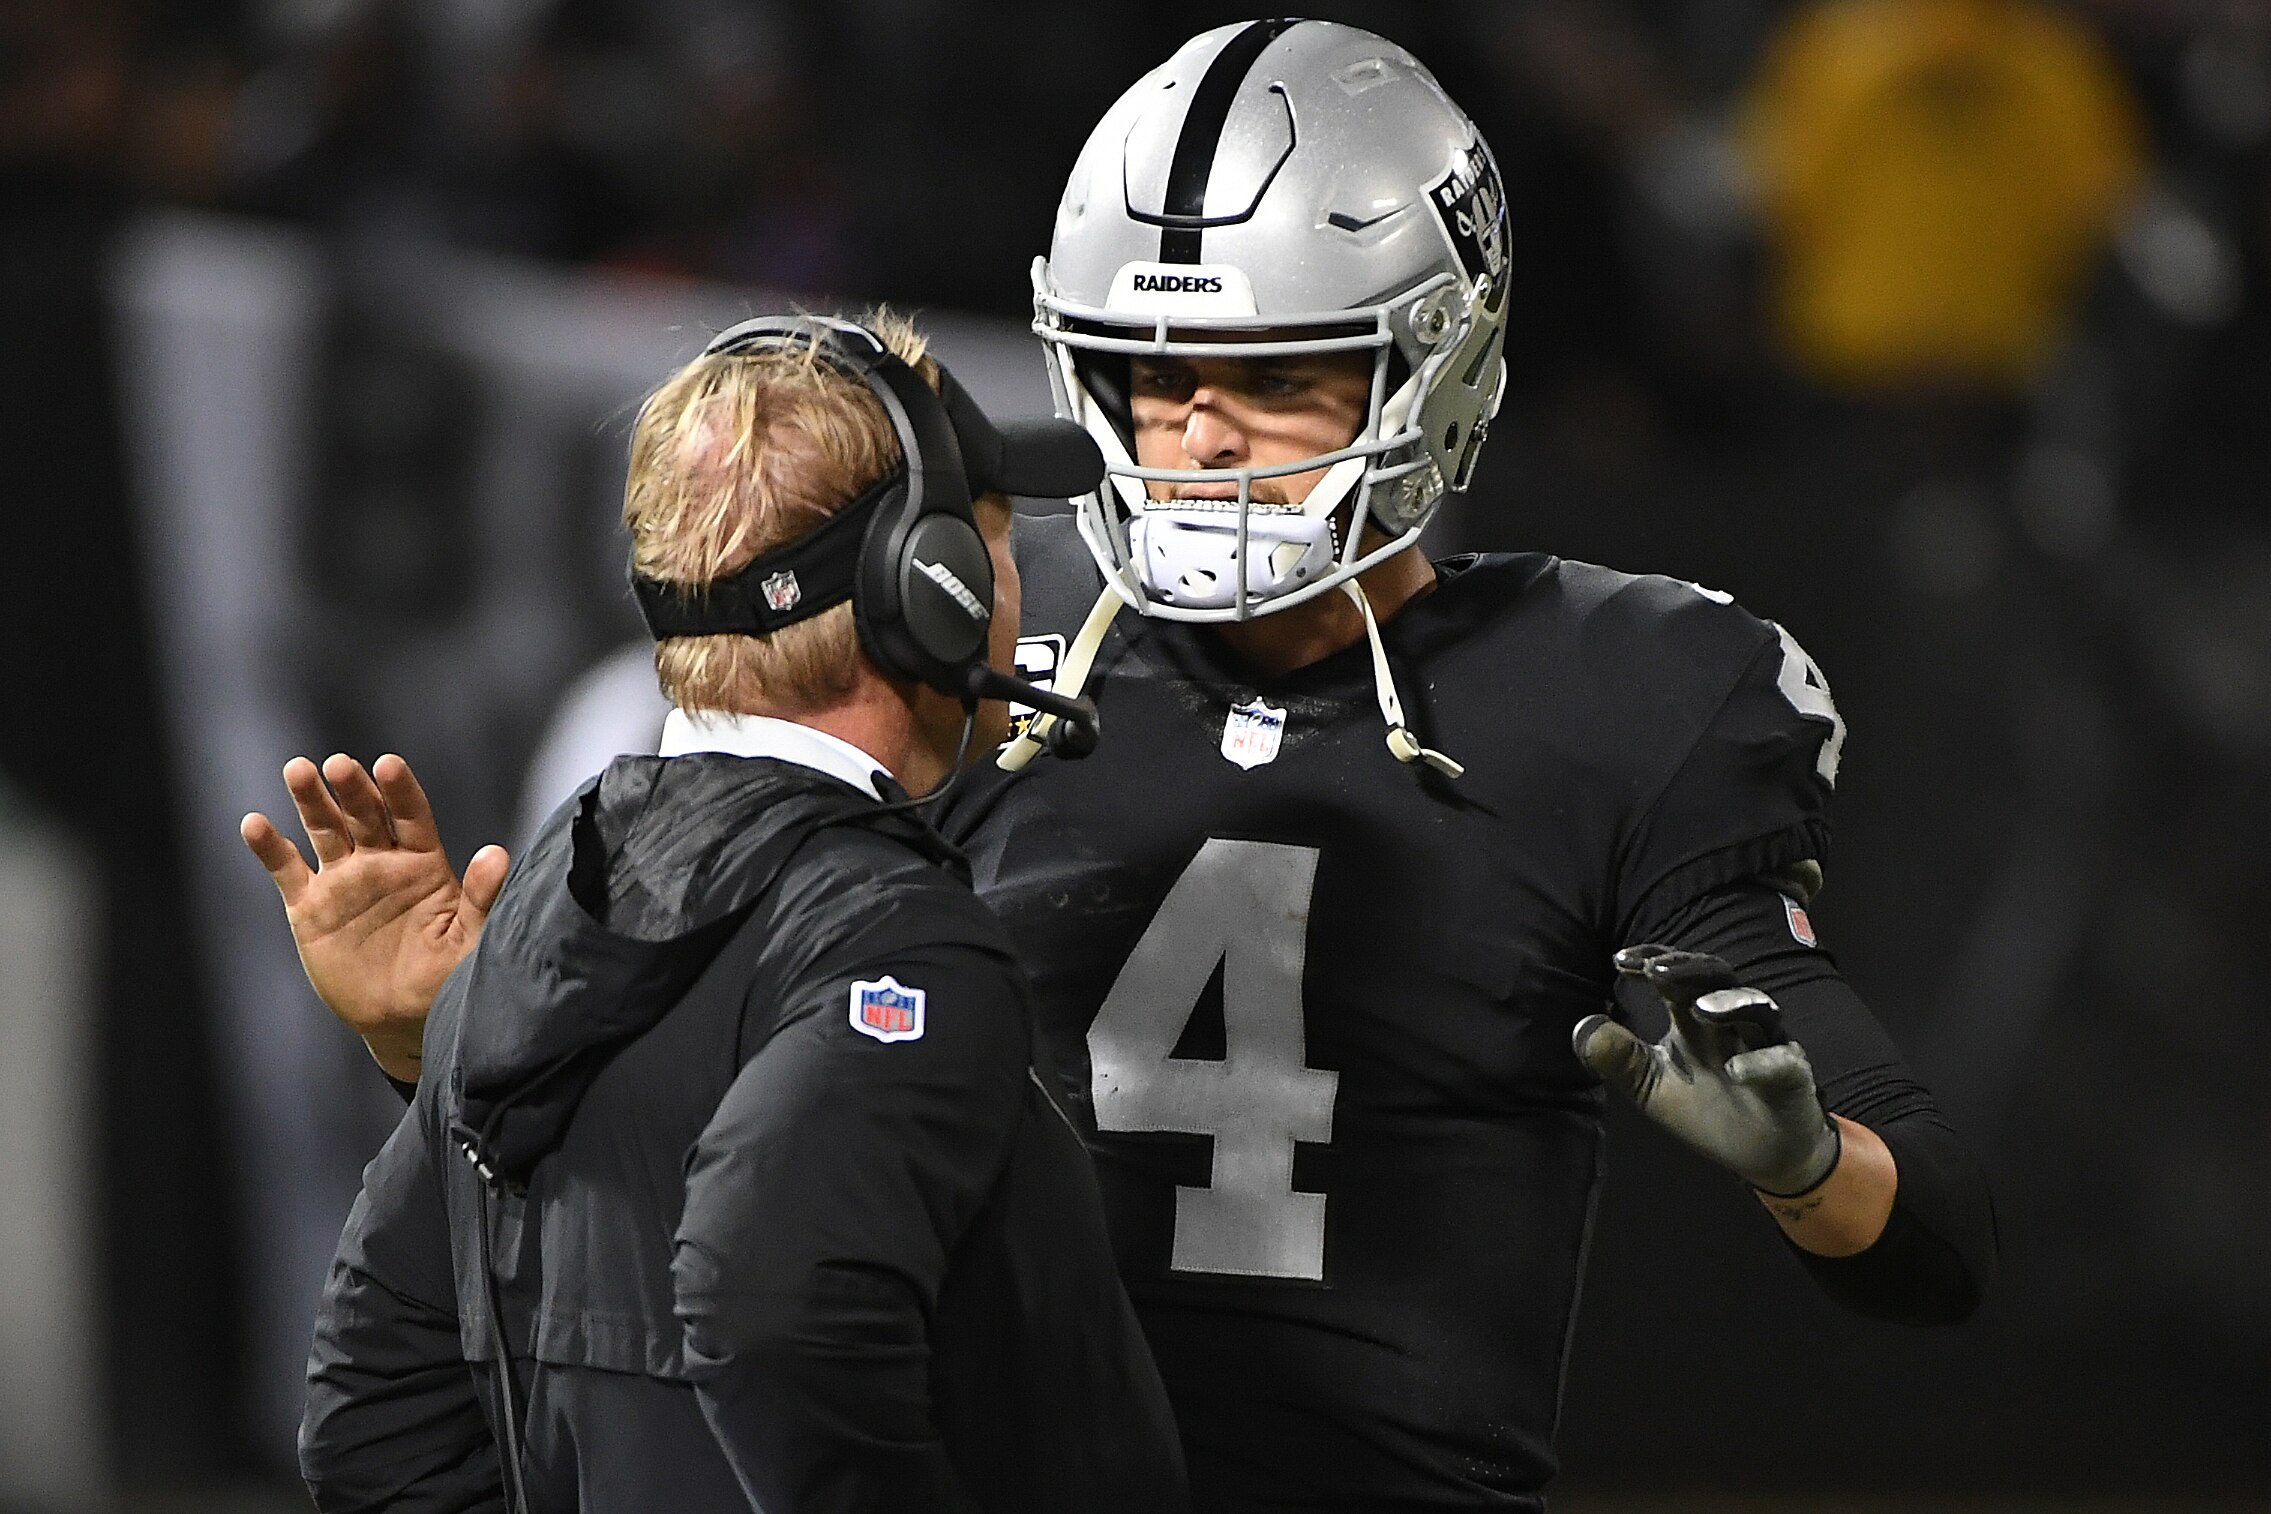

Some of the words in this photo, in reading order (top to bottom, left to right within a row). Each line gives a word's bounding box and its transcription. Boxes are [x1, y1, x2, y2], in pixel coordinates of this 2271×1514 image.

[1133, 274, 1222, 293] RAIDERS
[911, 557, 990, 621] BOSE
[865, 1003, 913, 1032] NFL
[1086, 836, 1340, 1282] 4
